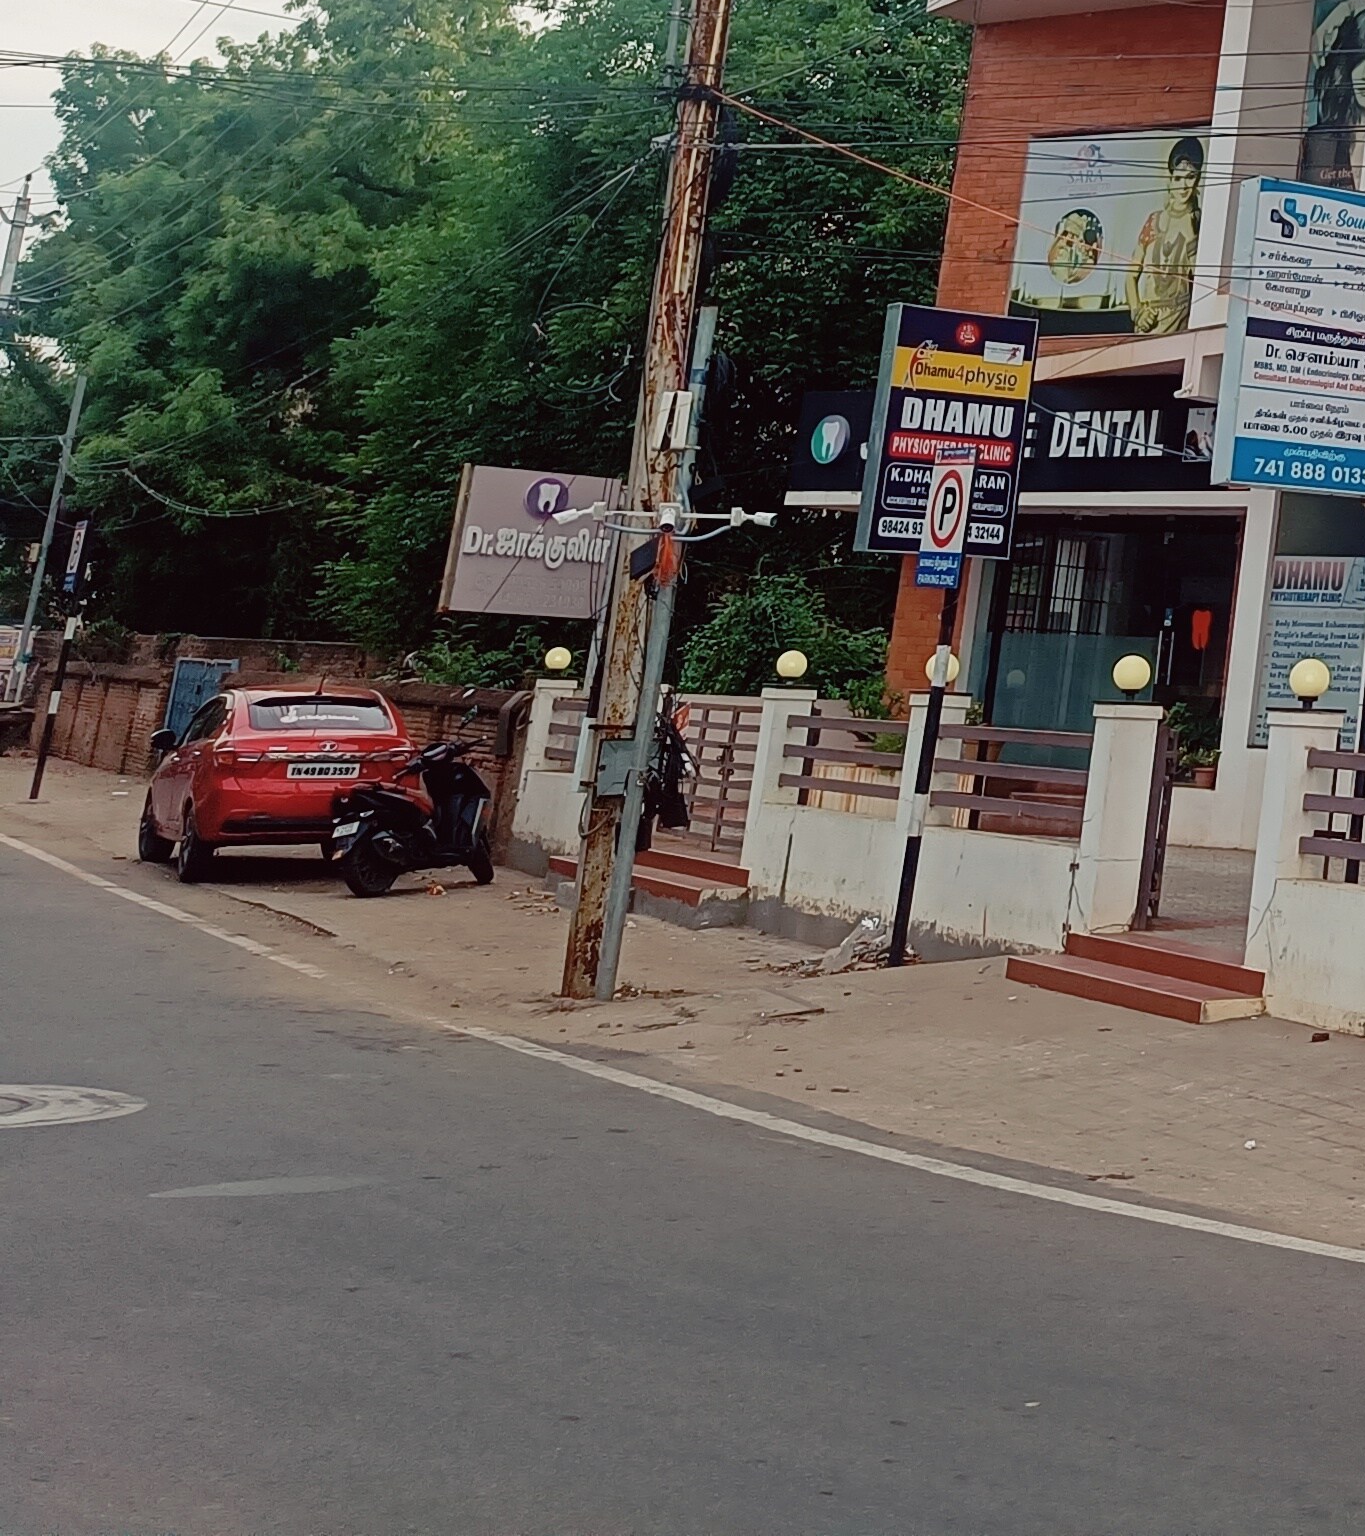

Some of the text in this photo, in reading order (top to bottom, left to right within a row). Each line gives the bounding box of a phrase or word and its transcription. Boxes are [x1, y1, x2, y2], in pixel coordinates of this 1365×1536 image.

[1310, 204, 1332, 224] Dr.
[1308, 227, 1350, 241] ENDOCRINE
[1266, 344, 1281, 359] Dr.
[915, 360, 1018, 389] Dhamu4physio
[900, 395, 1015, 438] DHAMU
[1048, 408, 1165, 459] DENTAL
[1282, 423, 1308, 435] 5.00
[1253, 457, 1284, 477] 741
[1290, 461, 1326, 481] 888
[881, 519, 910, 535] 98424
[974, 524, 1001, 541] 32144
[1272, 560, 1345, 591] DHAMU
[303, 767, 316, 776] 49
[331, 767, 356, 776] 3597
